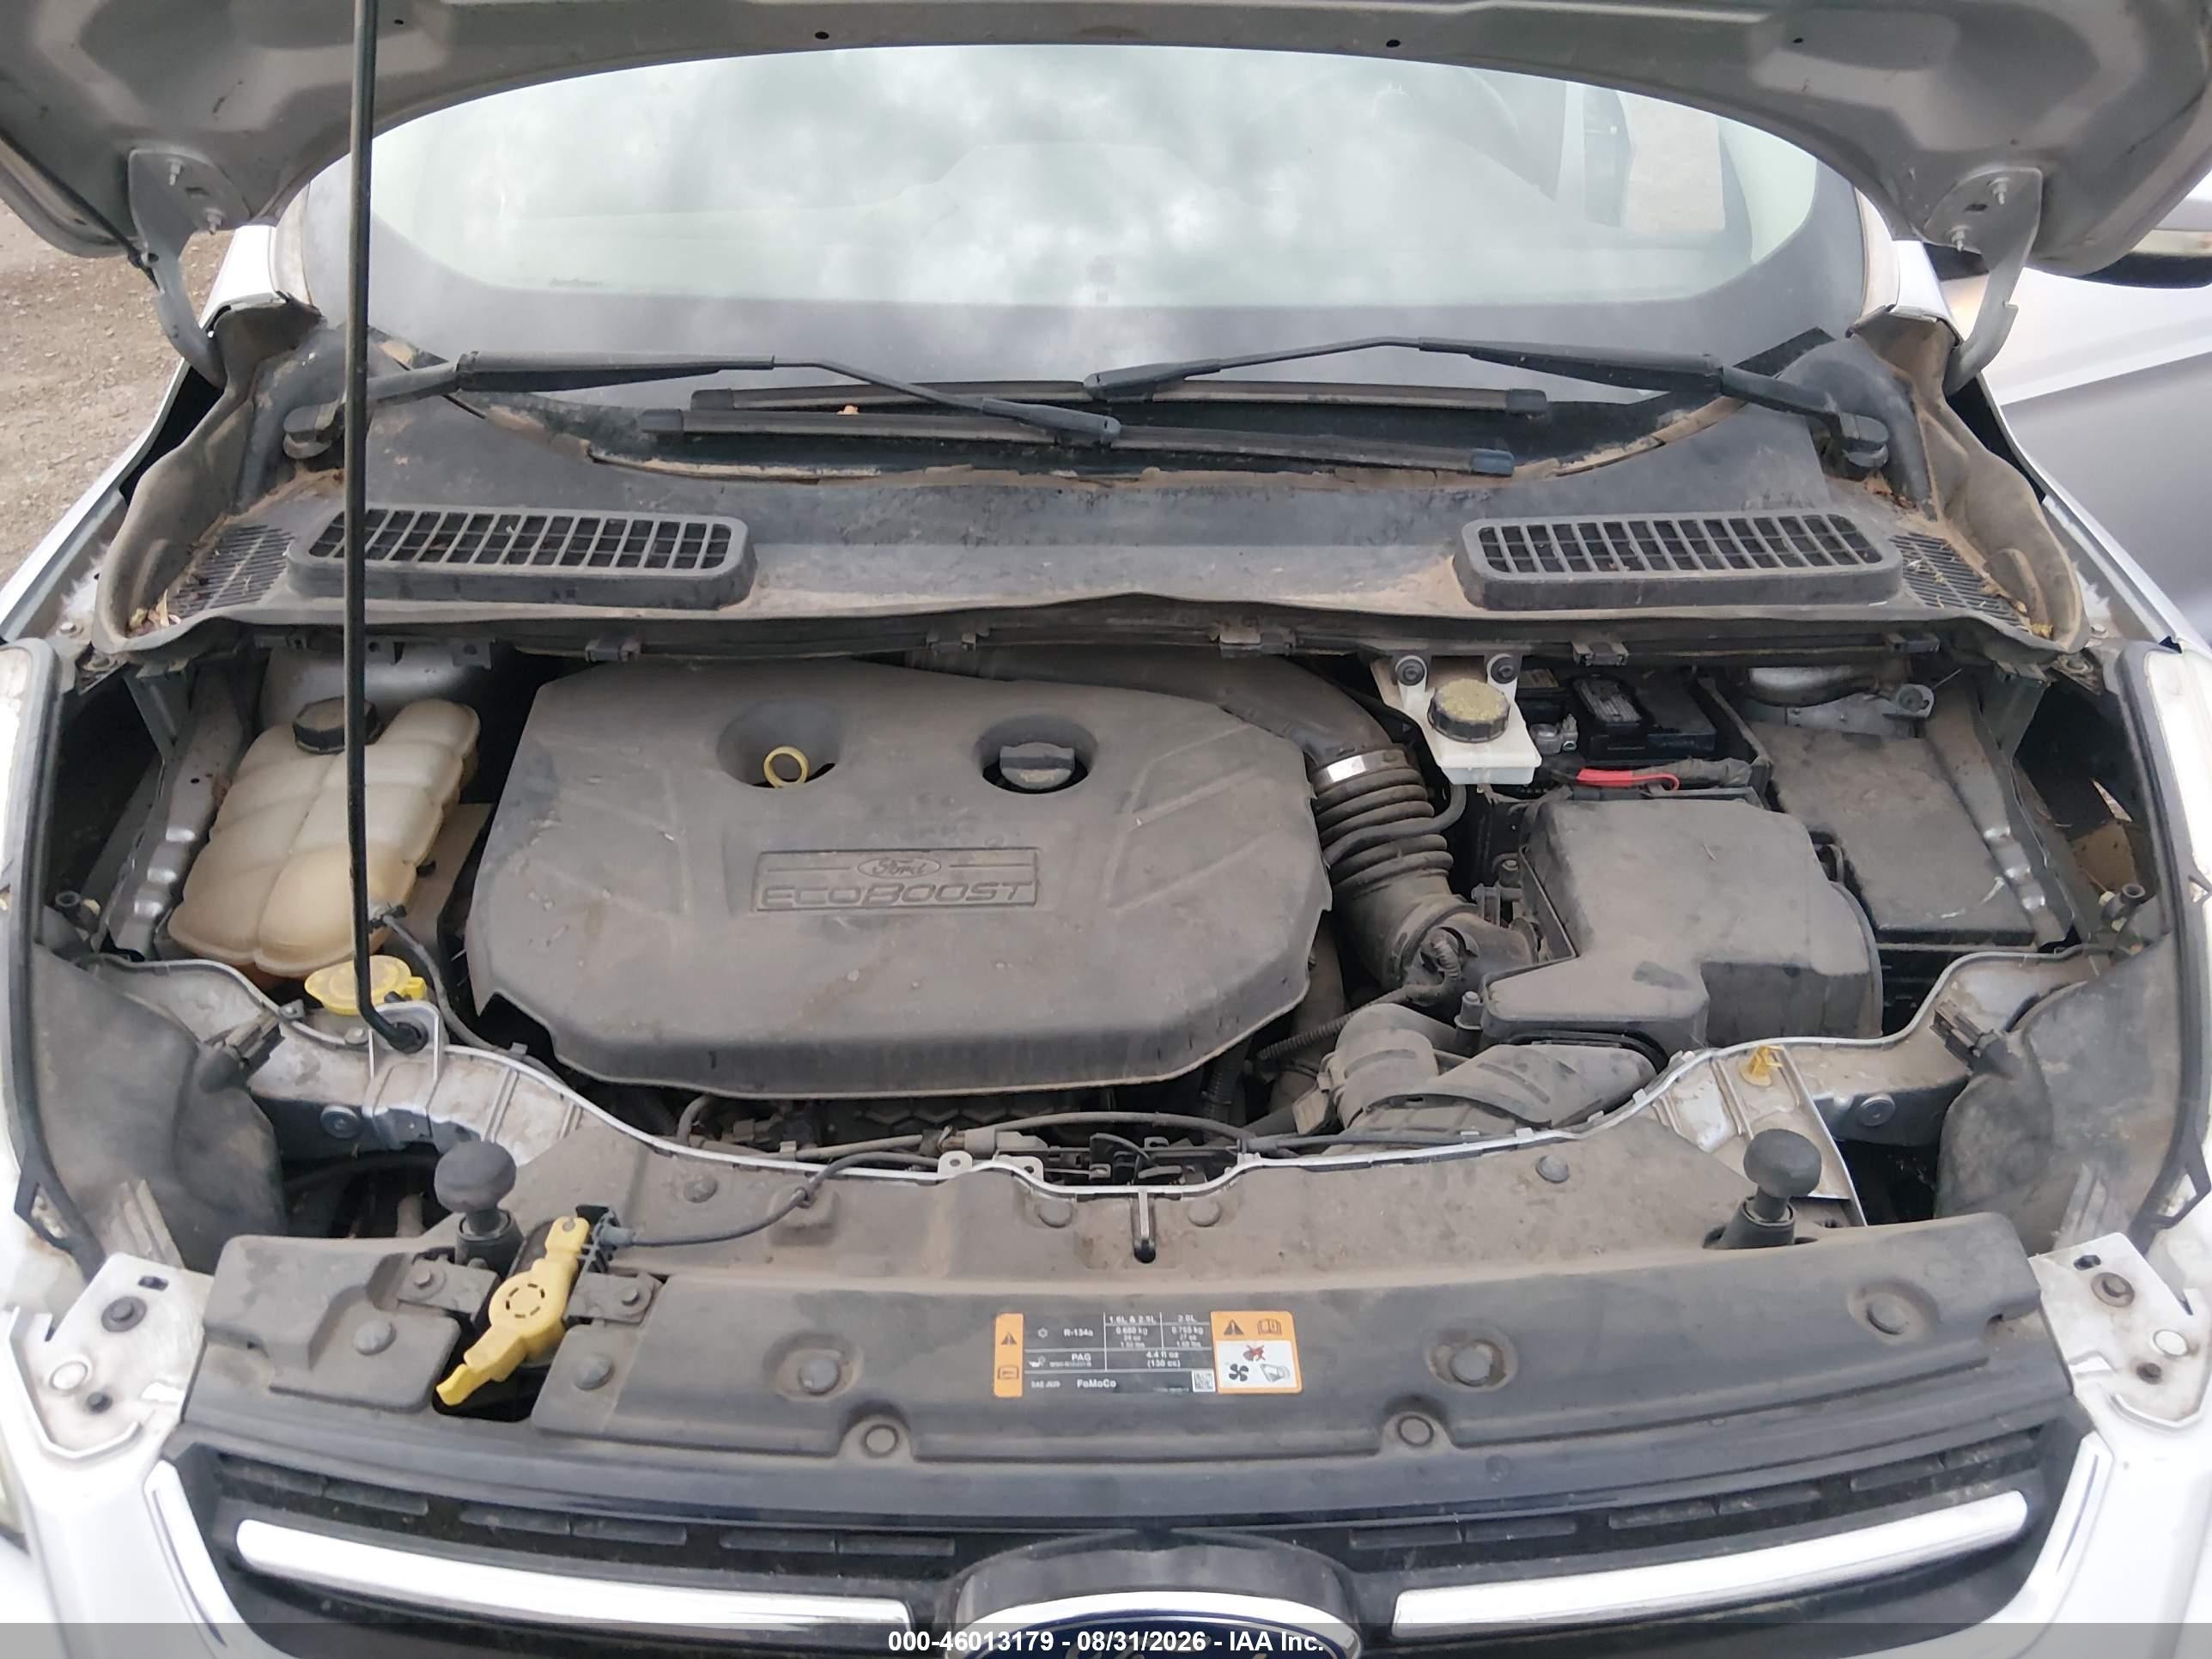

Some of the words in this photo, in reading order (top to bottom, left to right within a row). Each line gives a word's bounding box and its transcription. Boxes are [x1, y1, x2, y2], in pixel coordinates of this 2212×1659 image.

[872, 857, 927, 877] Ford
[1063, 1328, 1094, 1337] R-134a
[1071, 1352, 1091, 1361] PAG
[1076, 1378, 1117, 1389] FoMoCo
